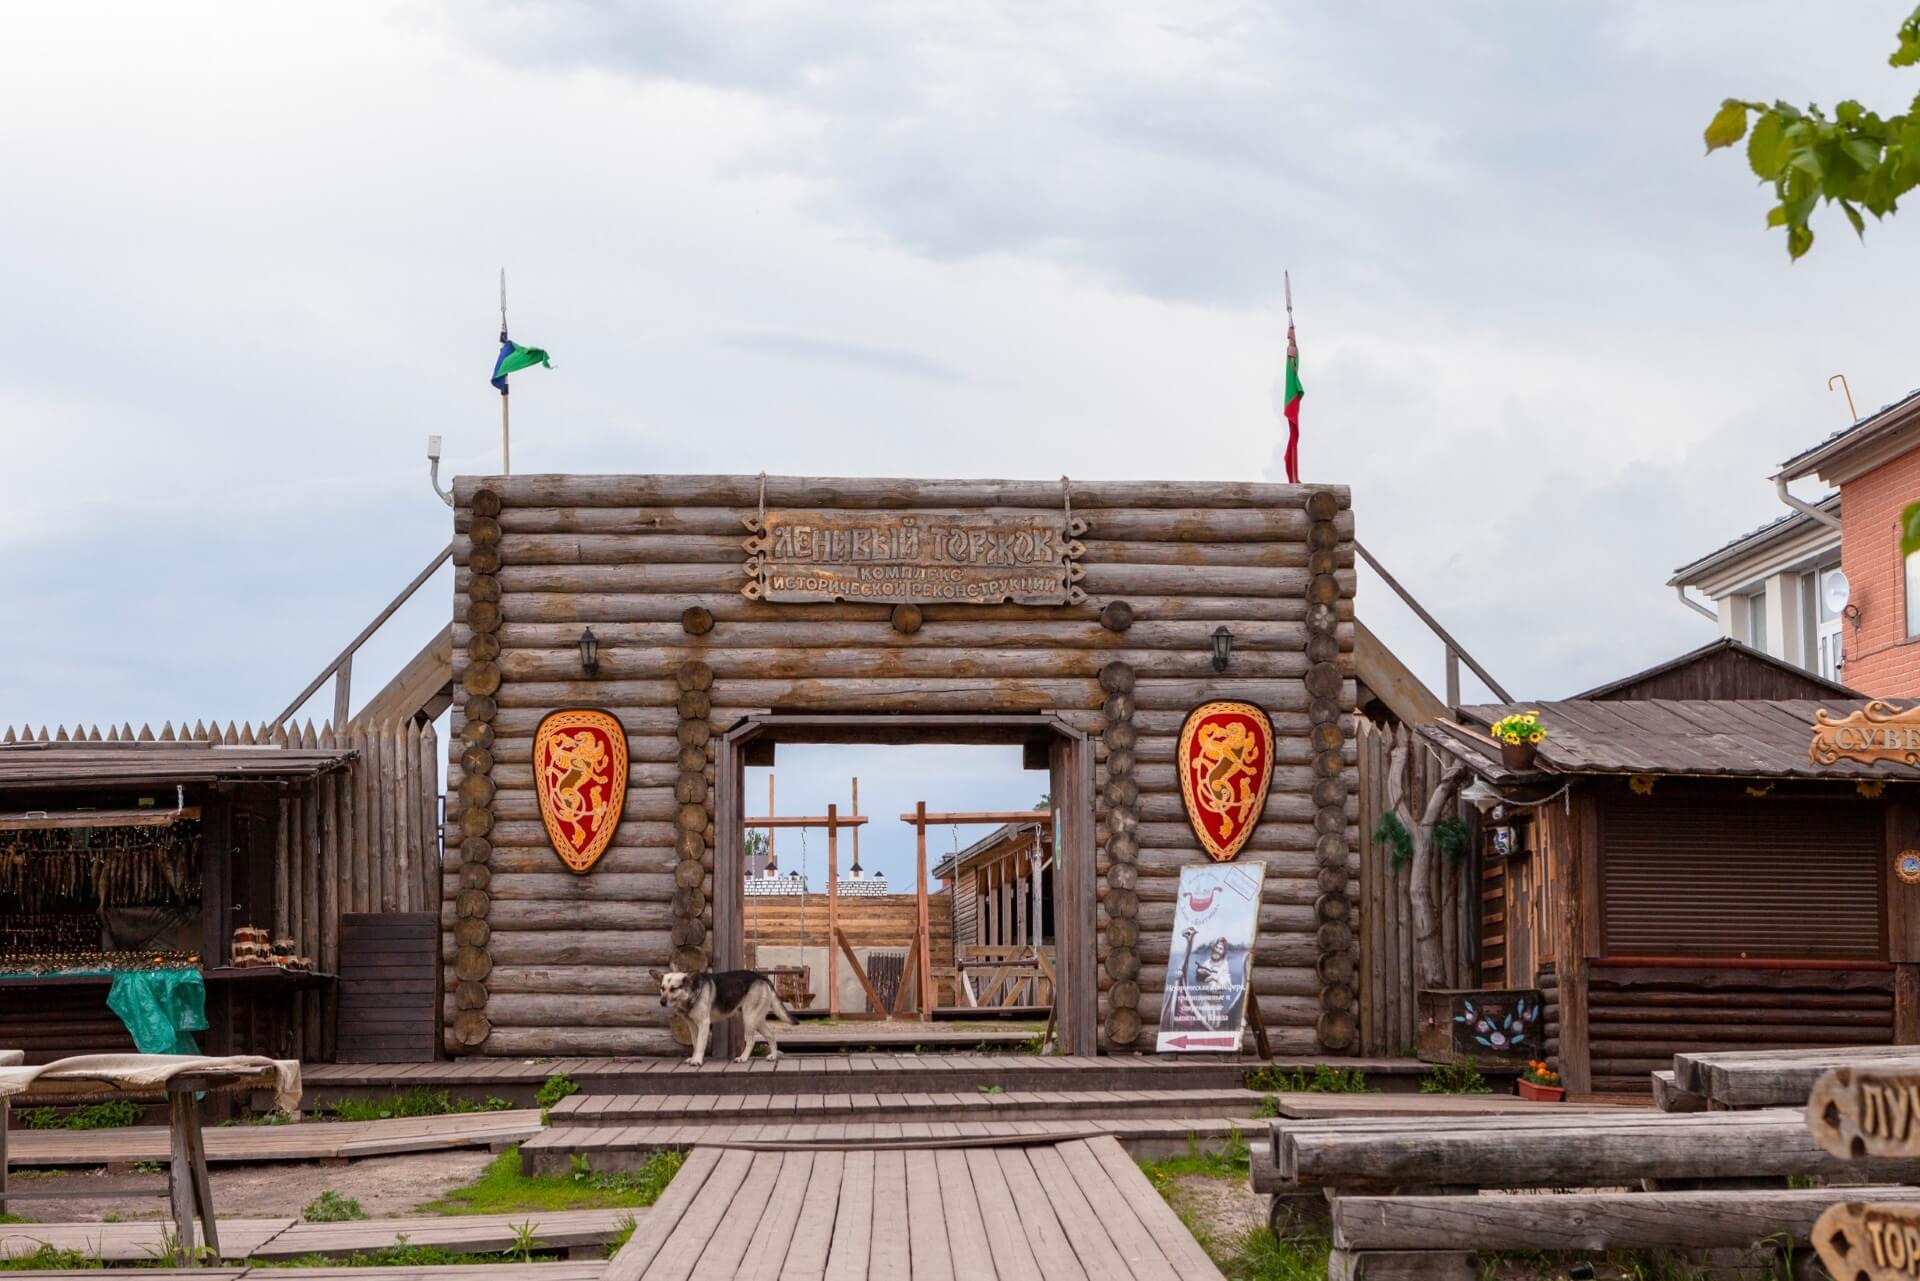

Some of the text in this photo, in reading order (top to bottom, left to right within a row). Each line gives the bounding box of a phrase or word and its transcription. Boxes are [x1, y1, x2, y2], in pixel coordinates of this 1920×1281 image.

[774, 518, 1054, 566] ЛЕНИВЫЙ ТОРЖОК
[860, 565, 963, 582] КОМПЛЕКС
[773, 575, 1057, 598] ИСТОРИЧЕСКОЙ РЕКОНСТРУКЦИИ
